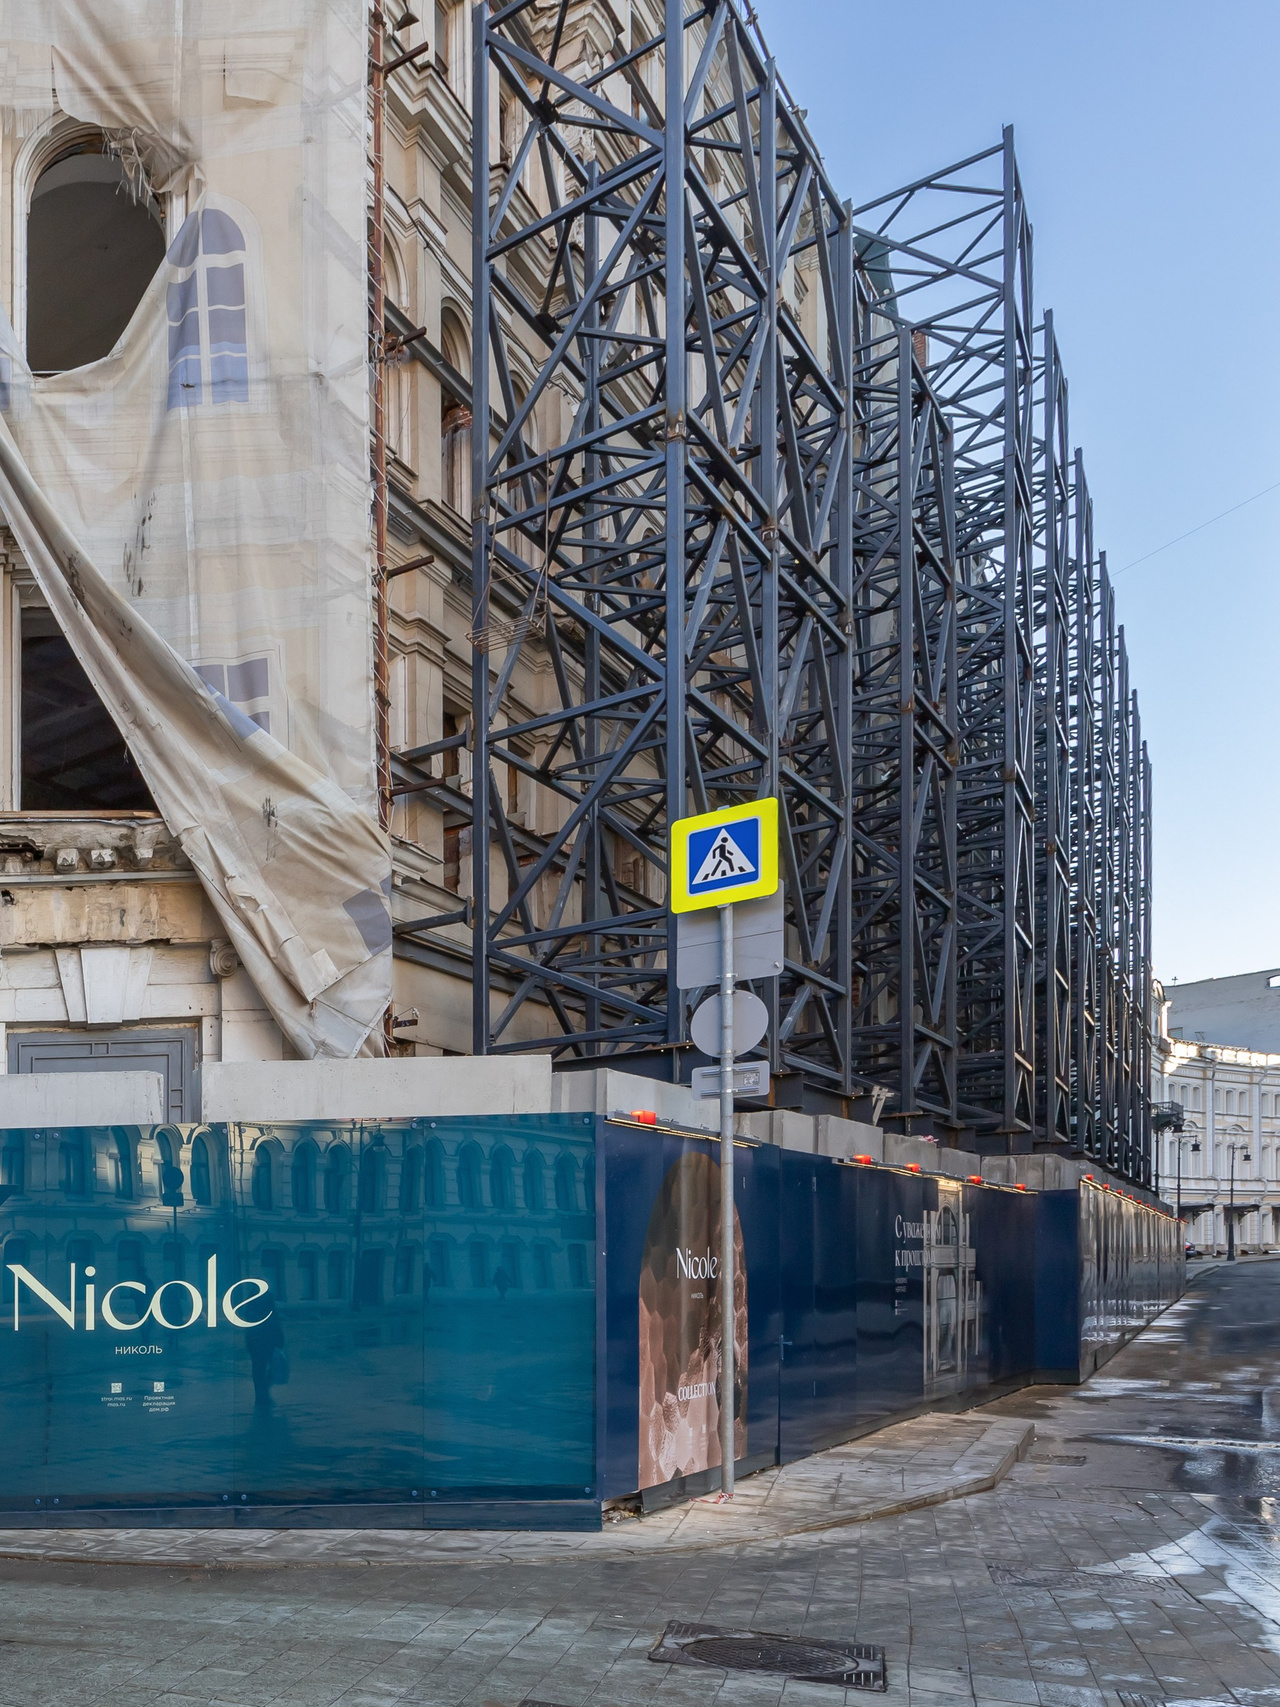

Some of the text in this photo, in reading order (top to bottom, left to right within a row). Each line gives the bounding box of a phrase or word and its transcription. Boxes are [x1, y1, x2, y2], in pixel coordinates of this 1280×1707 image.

[676, 1246, 718, 1279] Nicole
[6, 1253, 273, 1331] Nicole
[678, 1382, 716, 1401] COLLECTION
